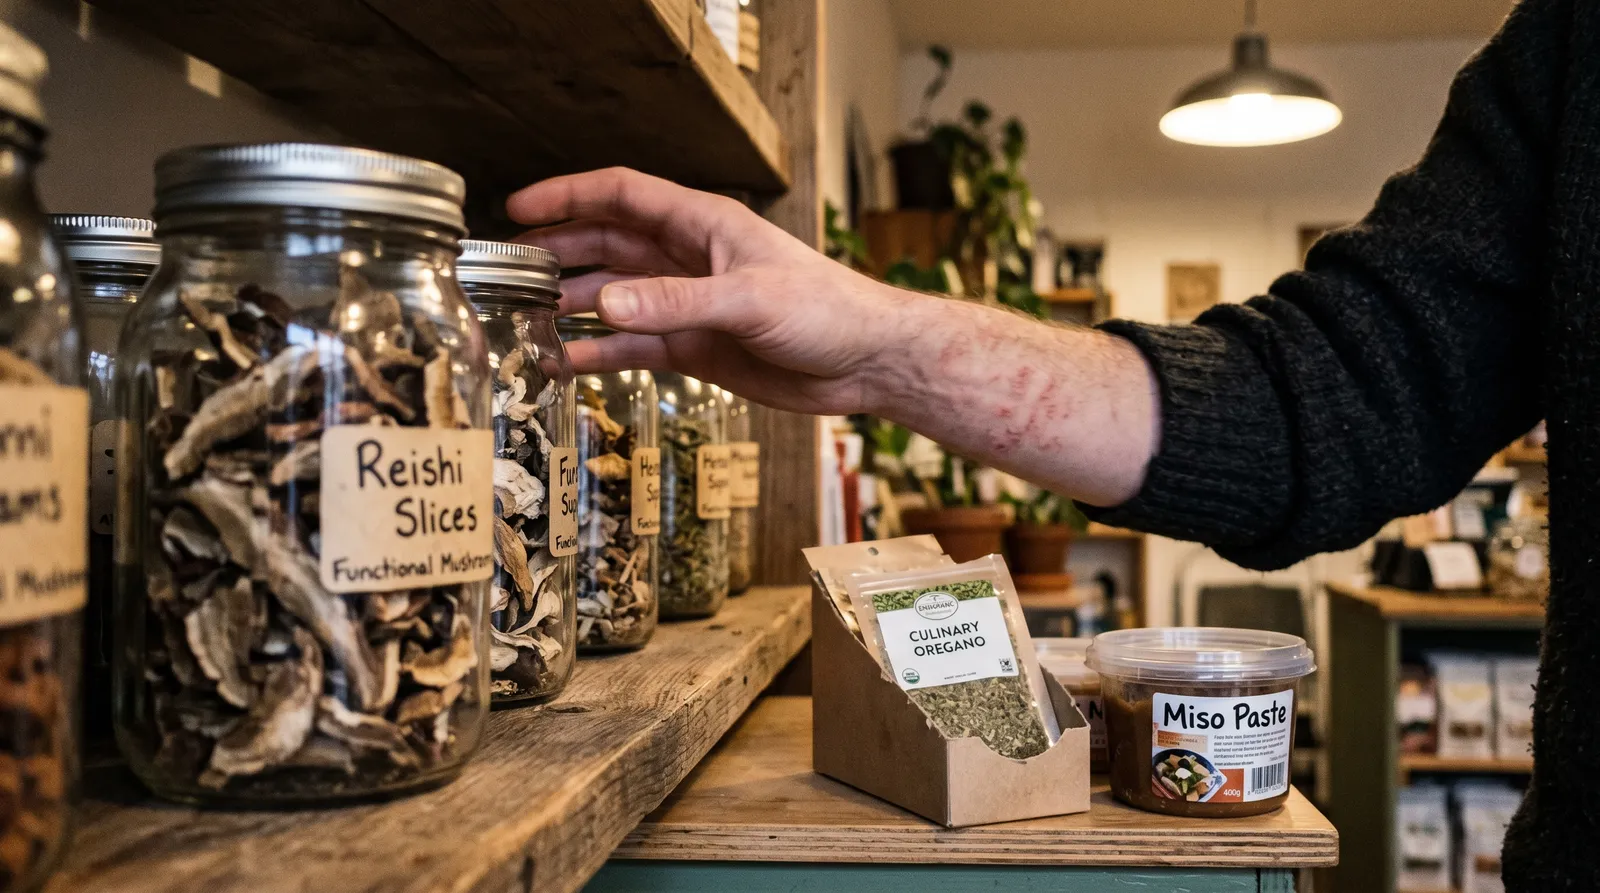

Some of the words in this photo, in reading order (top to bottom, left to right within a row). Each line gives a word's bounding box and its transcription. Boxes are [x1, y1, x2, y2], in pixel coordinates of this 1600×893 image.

[356, 439, 463, 489] Reishi
[395, 498, 478, 537] Slices
[333, 554, 432, 582] Functional
[909, 621, 980, 642] CULINARY
[914, 636, 986, 657] OREGANO
[1163, 702, 1225, 730] Miso
[1232, 700, 1287, 730] Paste
[1223, 788, 1241, 798] 400g
